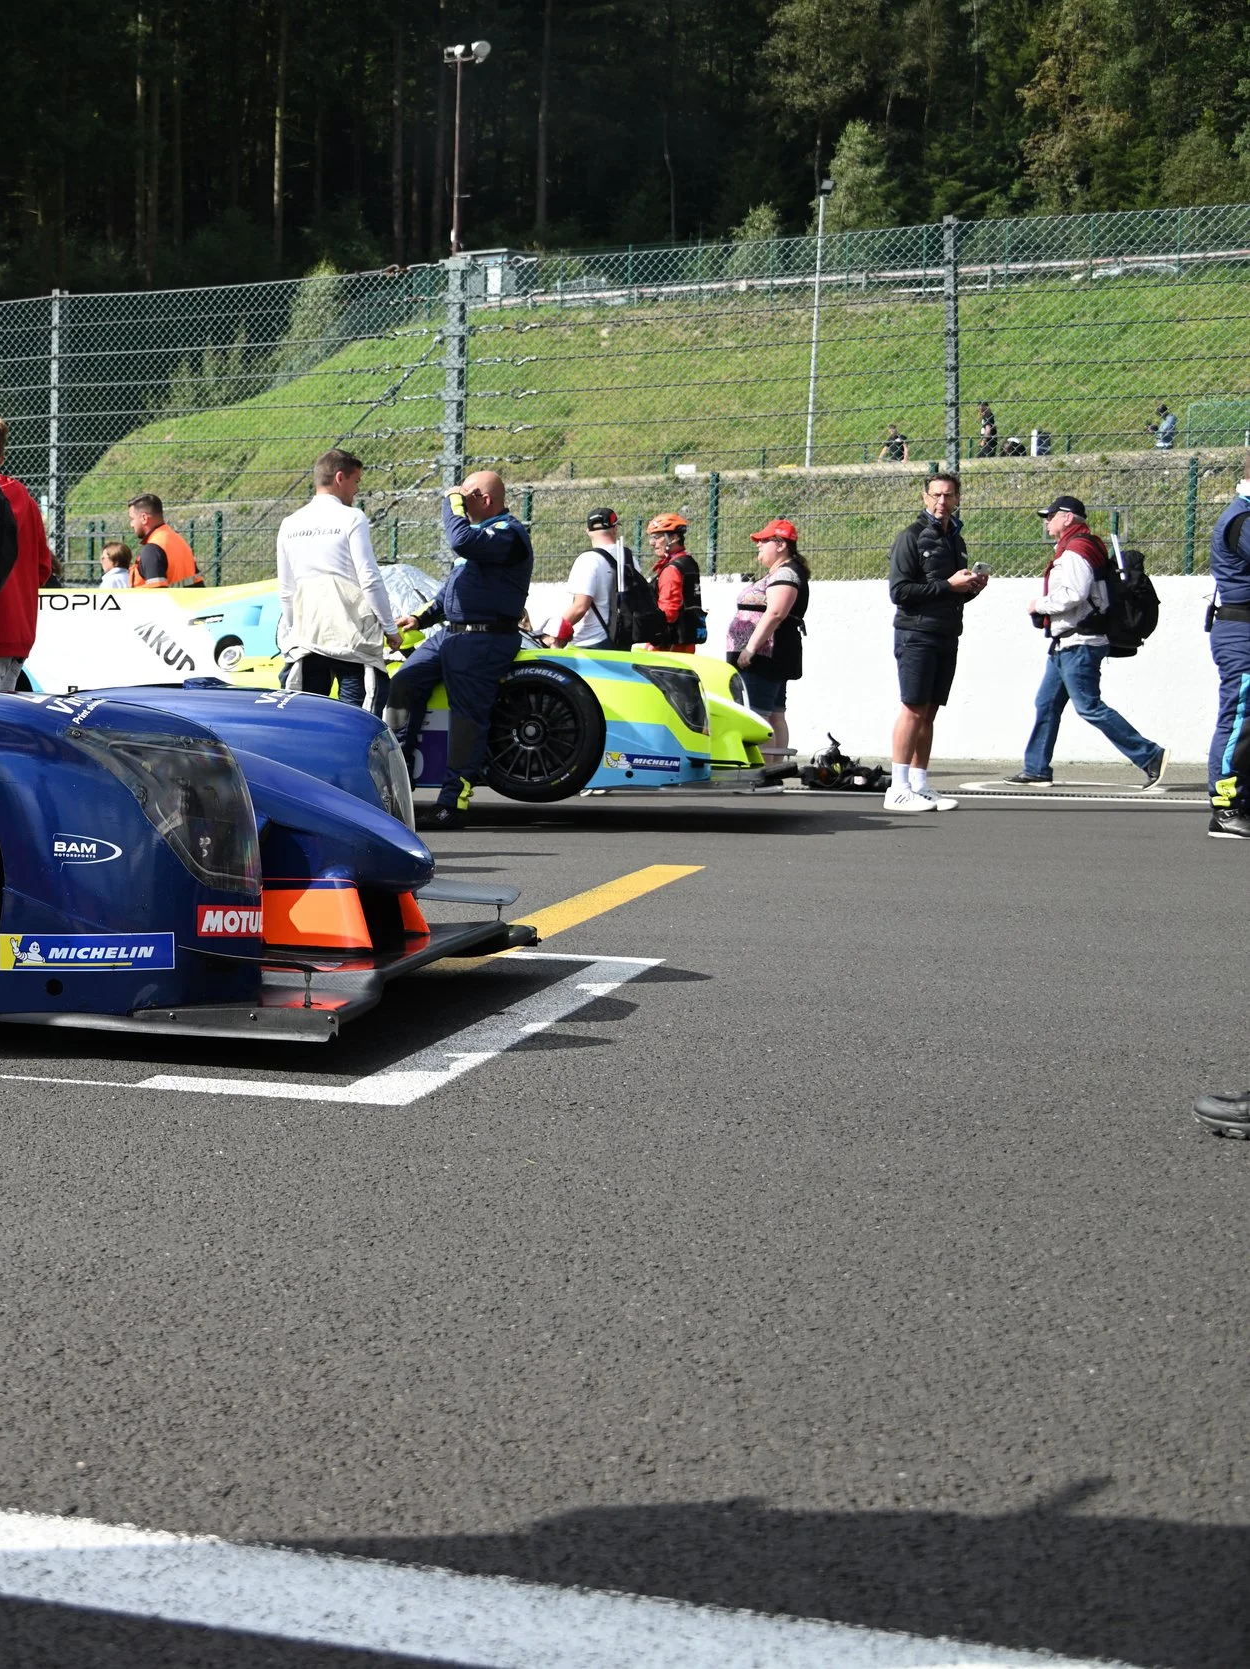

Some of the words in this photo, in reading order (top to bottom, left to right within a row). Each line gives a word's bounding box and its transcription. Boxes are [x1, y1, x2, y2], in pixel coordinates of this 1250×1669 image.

[515, 667, 566, 683] MICHELIN
[632, 758, 680, 767] MICHELIN
[53, 841, 97, 854] BAM
[48, 946, 154, 960] MICHELIN
